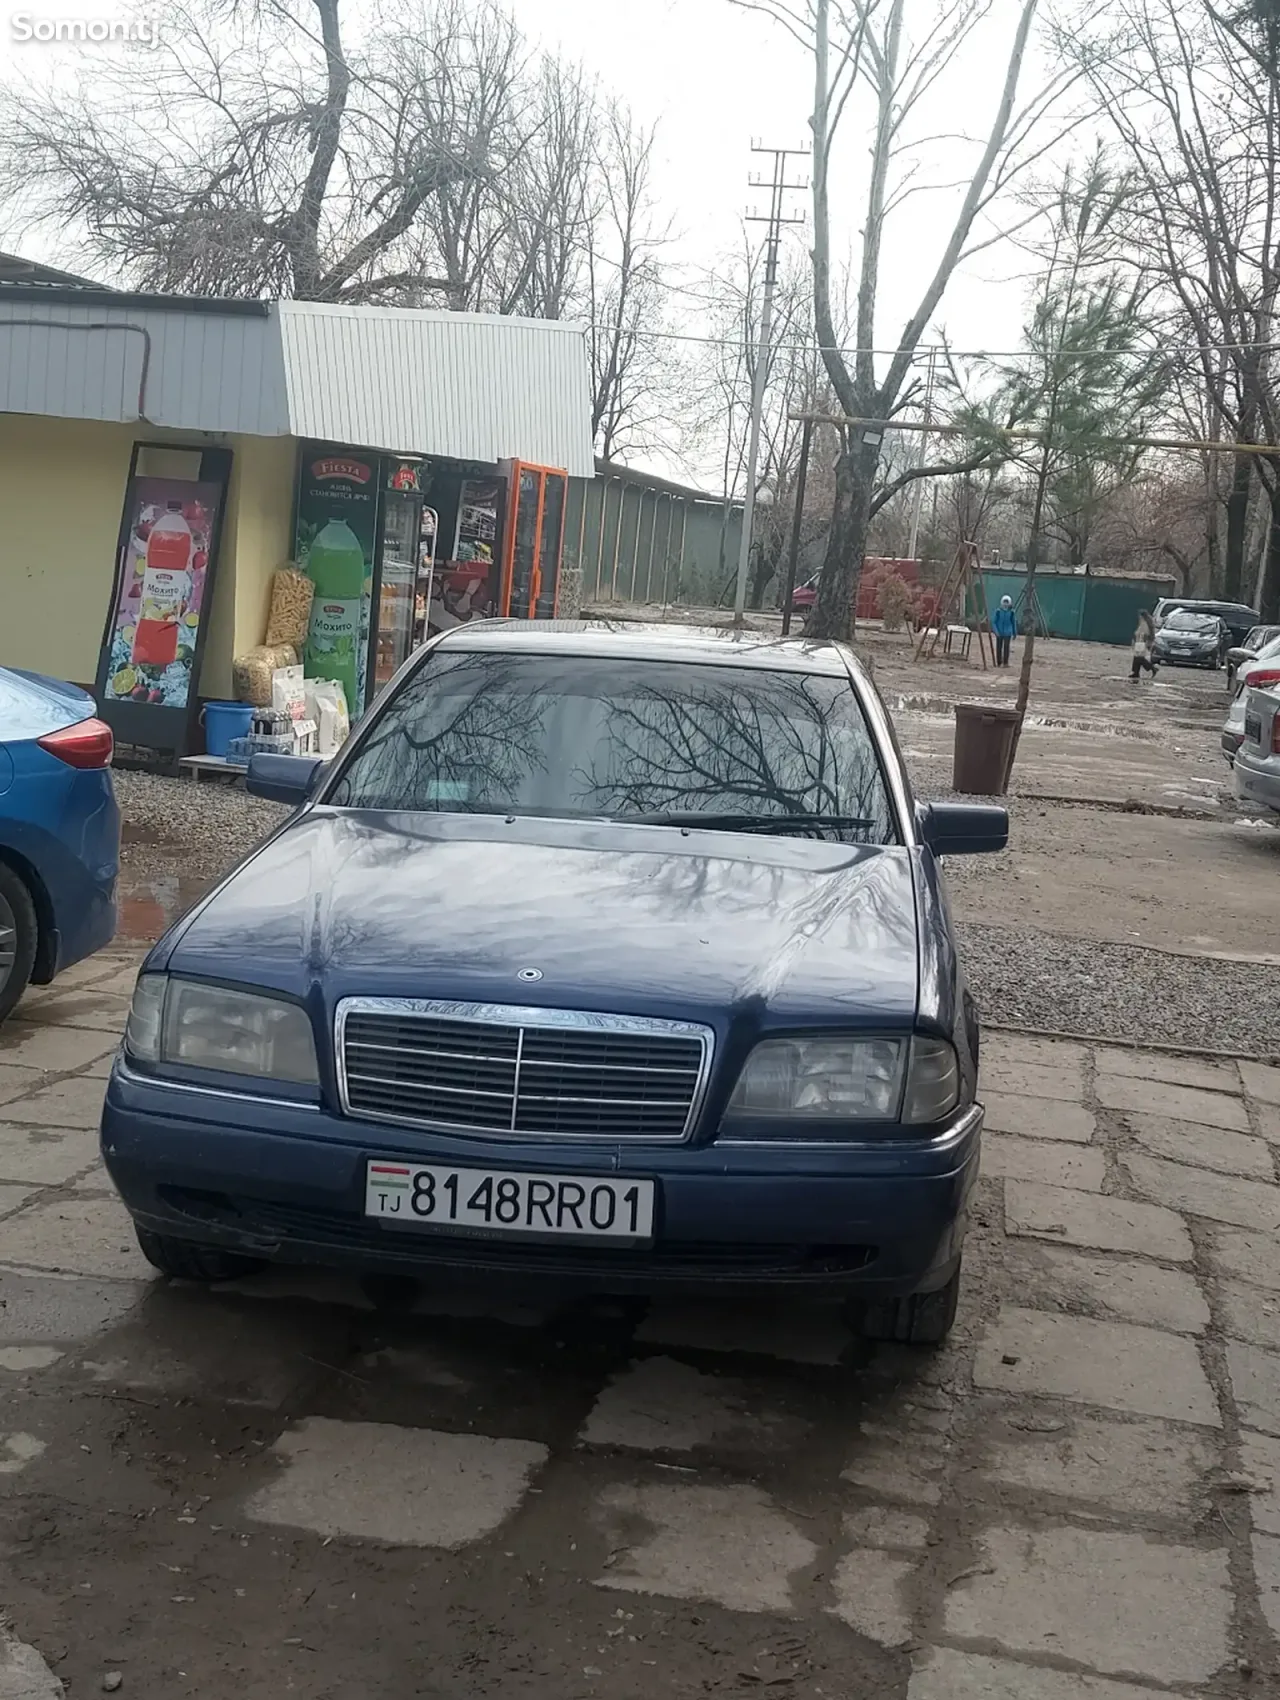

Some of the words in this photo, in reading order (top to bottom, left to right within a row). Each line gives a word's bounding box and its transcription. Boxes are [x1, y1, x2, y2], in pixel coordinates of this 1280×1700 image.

[314, 617, 353, 631] Мохито
[378, 1193, 401, 1213] TJ
[410, 1170, 640, 1232] 8148RR01
